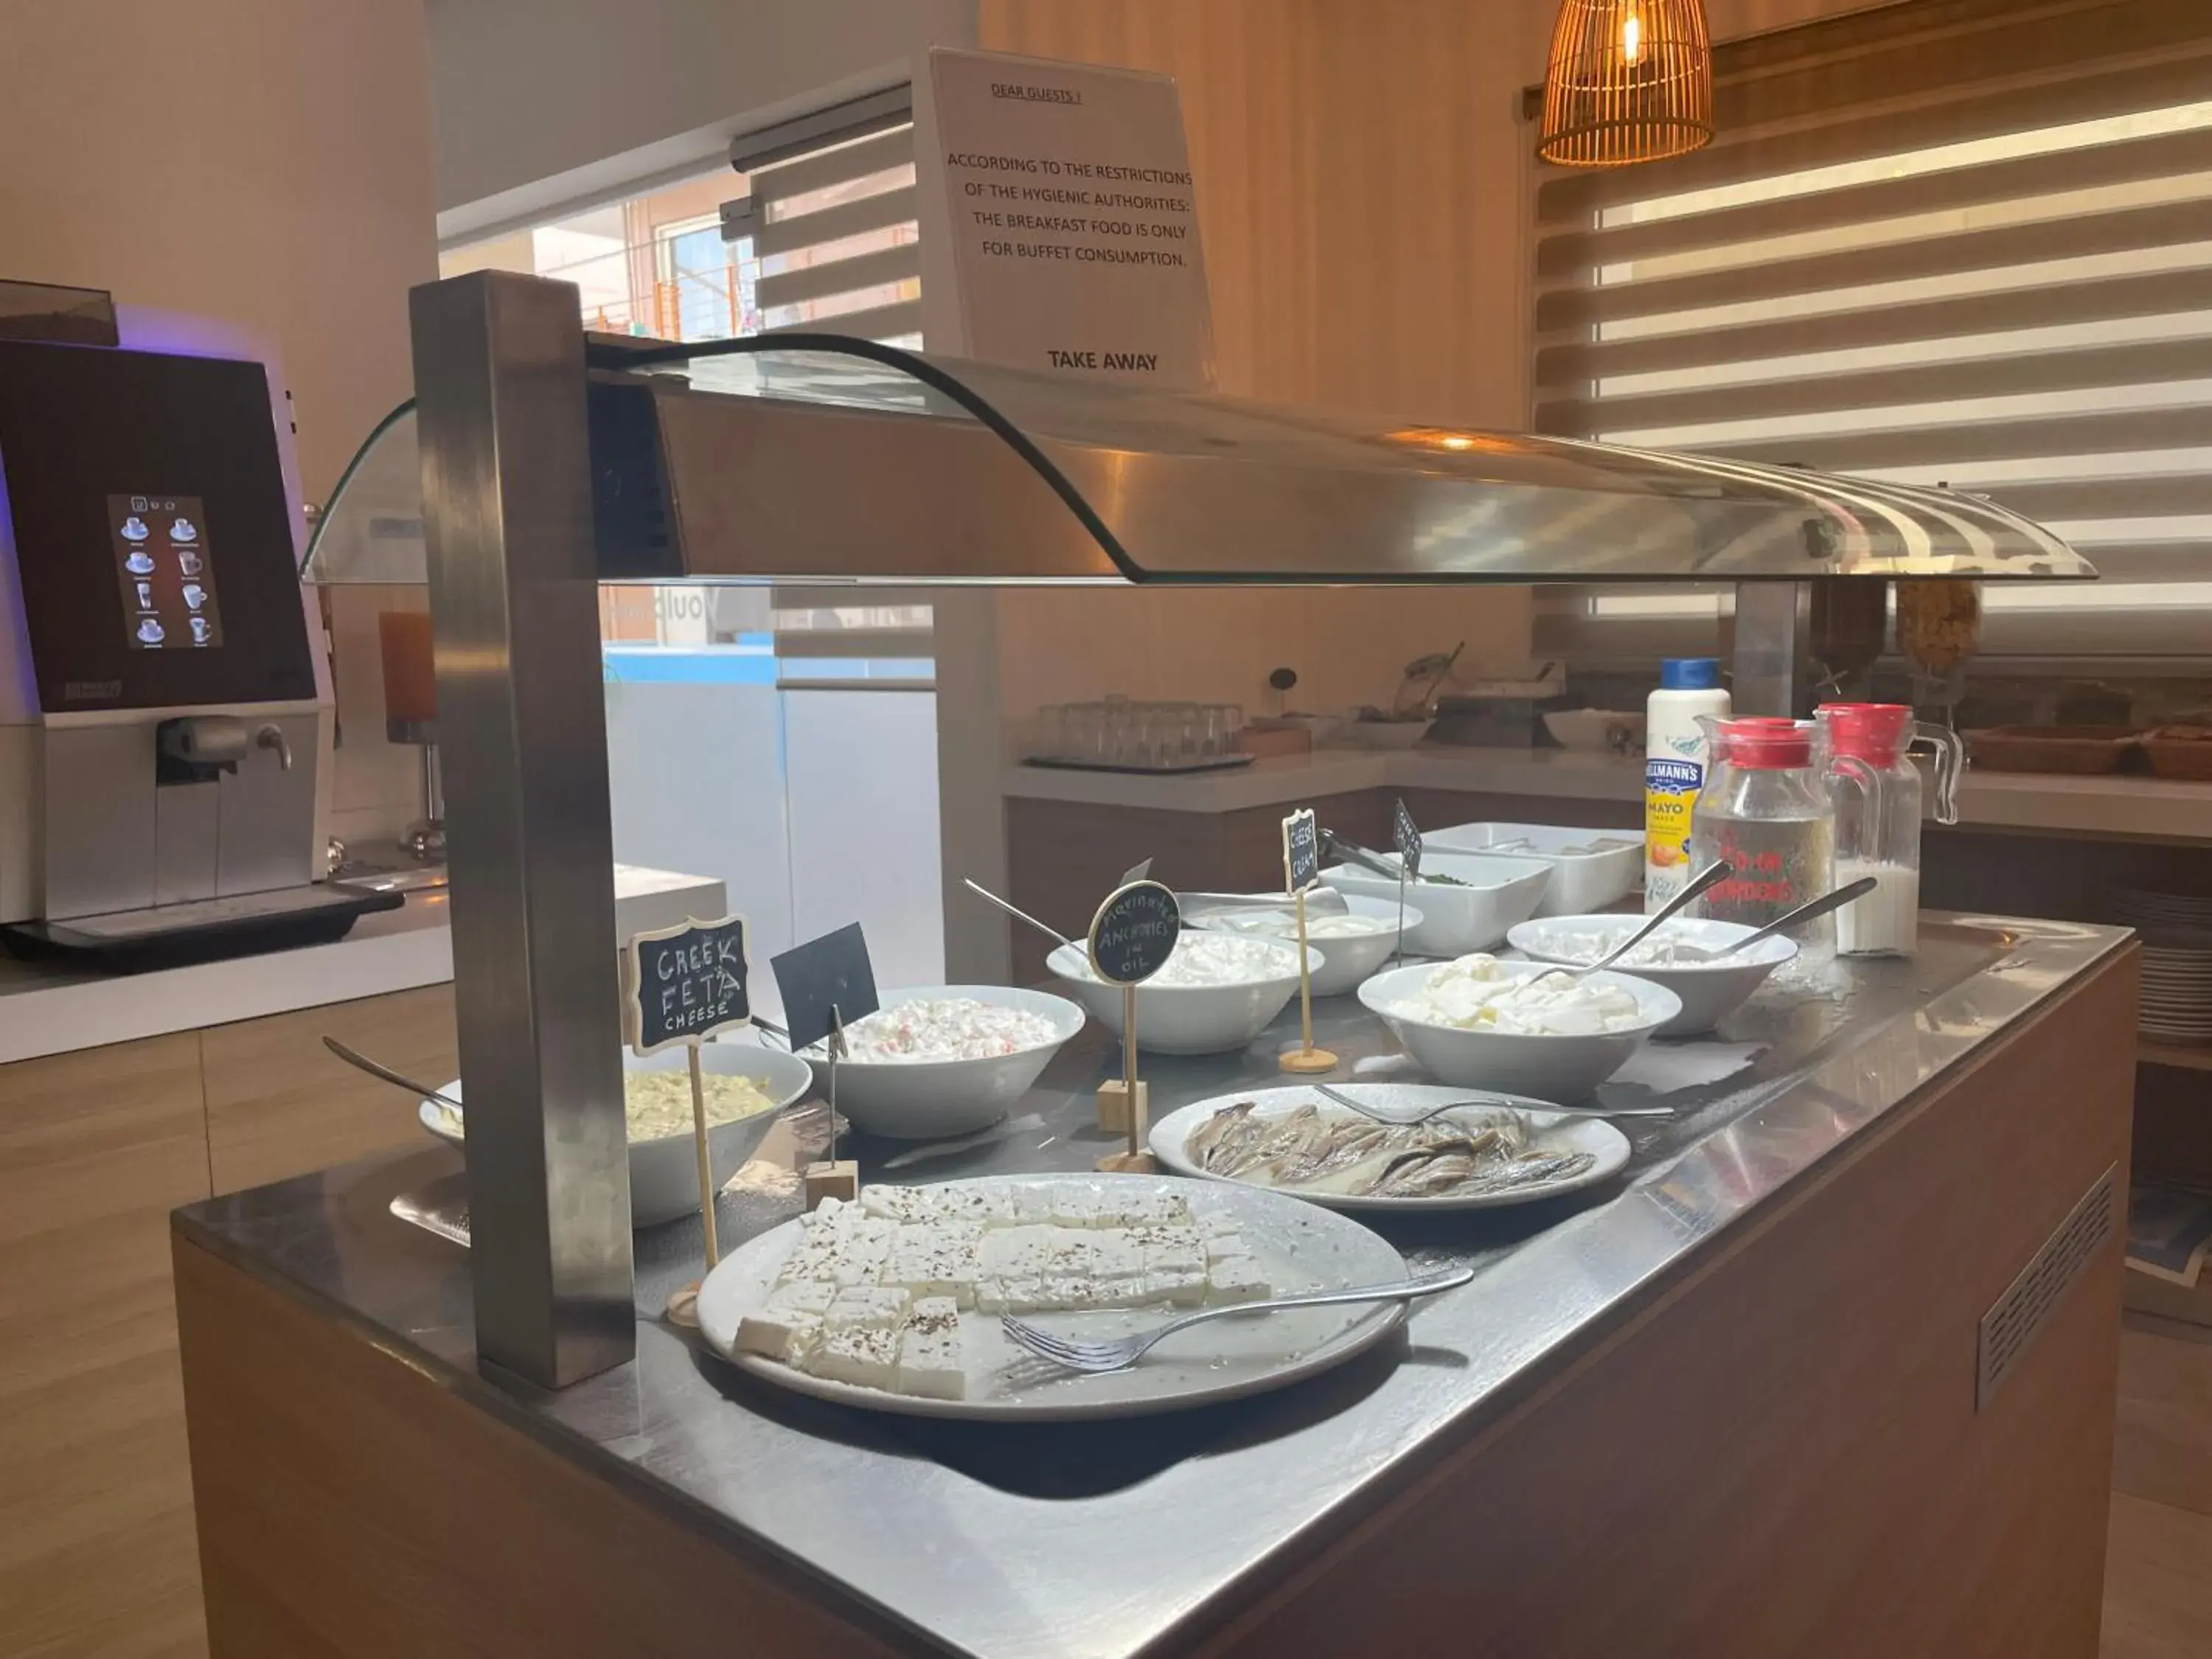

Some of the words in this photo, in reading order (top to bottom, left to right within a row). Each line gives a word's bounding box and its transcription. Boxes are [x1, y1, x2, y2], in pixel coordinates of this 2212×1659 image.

[991, 83, 1024, 98] DEAR
[1027, 87, 1074, 102] GUESTS
[947, 153, 1037, 173] ACCORDING
[1041, 161, 1060, 175] TO
[1064, 162, 1092, 178] THE
[1096, 166, 1193, 185] RESTRICTIONS
[964, 181, 987, 197] OF
[989, 184, 1018, 200] THE
[1023, 189, 1091, 205] HYGIENIC
[973, 212, 1002, 226] THE
[1007, 214, 1086, 232] BREAKFAST
[1092, 220, 1131, 235] FOOD
[1135, 223, 1148, 237] IS
[1151, 225, 1186, 239] ONLY
[982, 240, 1012, 257] FOR
[1017, 243, 1070, 260] BUFFET
[1075, 247, 1187, 268] CONSUMPTION.
[1046, 349, 1097, 369] TAKE
[1102, 352, 1158, 371] AWAY
[1649, 801, 1683, 815] MAYO
[662, 965, 740, 1015] FETA
[665, 1001, 728, 1030] CHEESE
